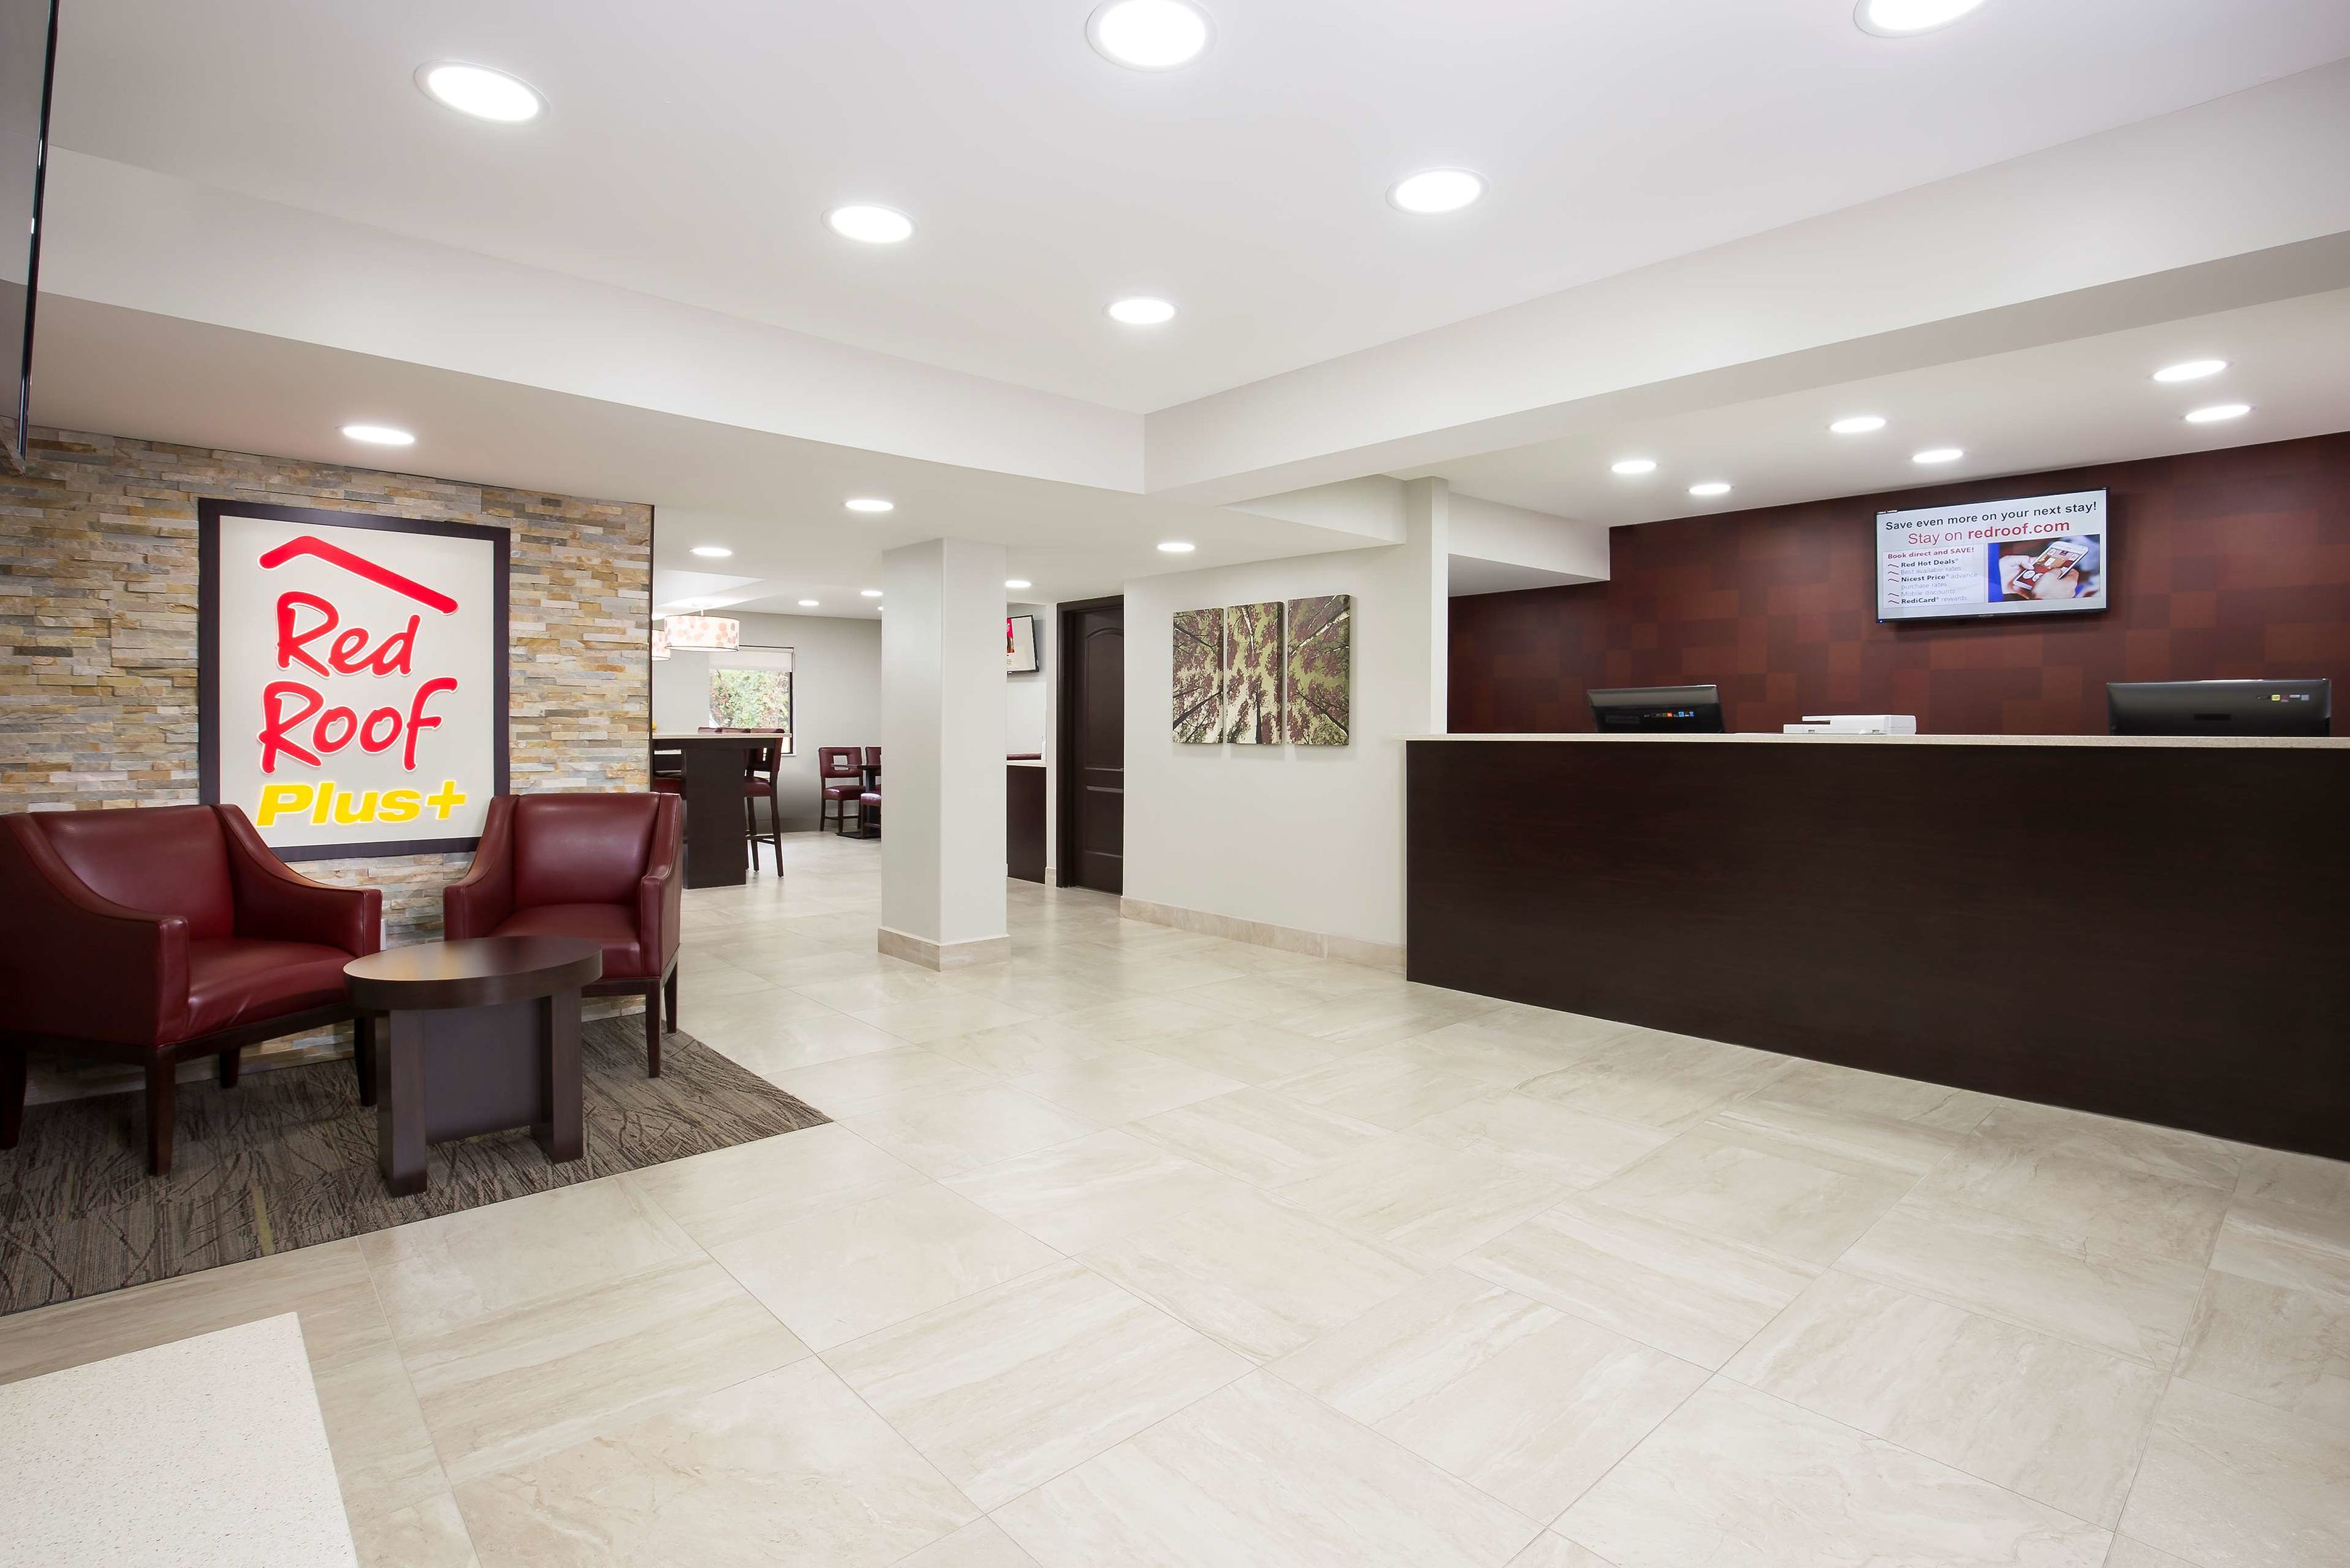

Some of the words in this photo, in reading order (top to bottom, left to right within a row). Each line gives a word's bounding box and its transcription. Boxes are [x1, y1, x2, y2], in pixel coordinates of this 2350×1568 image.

[1886, 522, 1913, 531] Save
[1917, 518, 1943, 528] even
[1948, 515, 1978, 524] more
[1982, 513, 1996, 521] on
[2002, 510, 2029, 521] your
[2034, 505, 2061, 516] next
[2065, 502, 2097, 513] stay!
[1909, 533, 1940, 545] Stay
[1945, 531, 1962, 542] on
[1968, 522, 2070, 539] redroof.com
[277, 591, 421, 677] Red
[258, 677, 458, 774] Roof
[256, 780, 466, 827] Plus+
